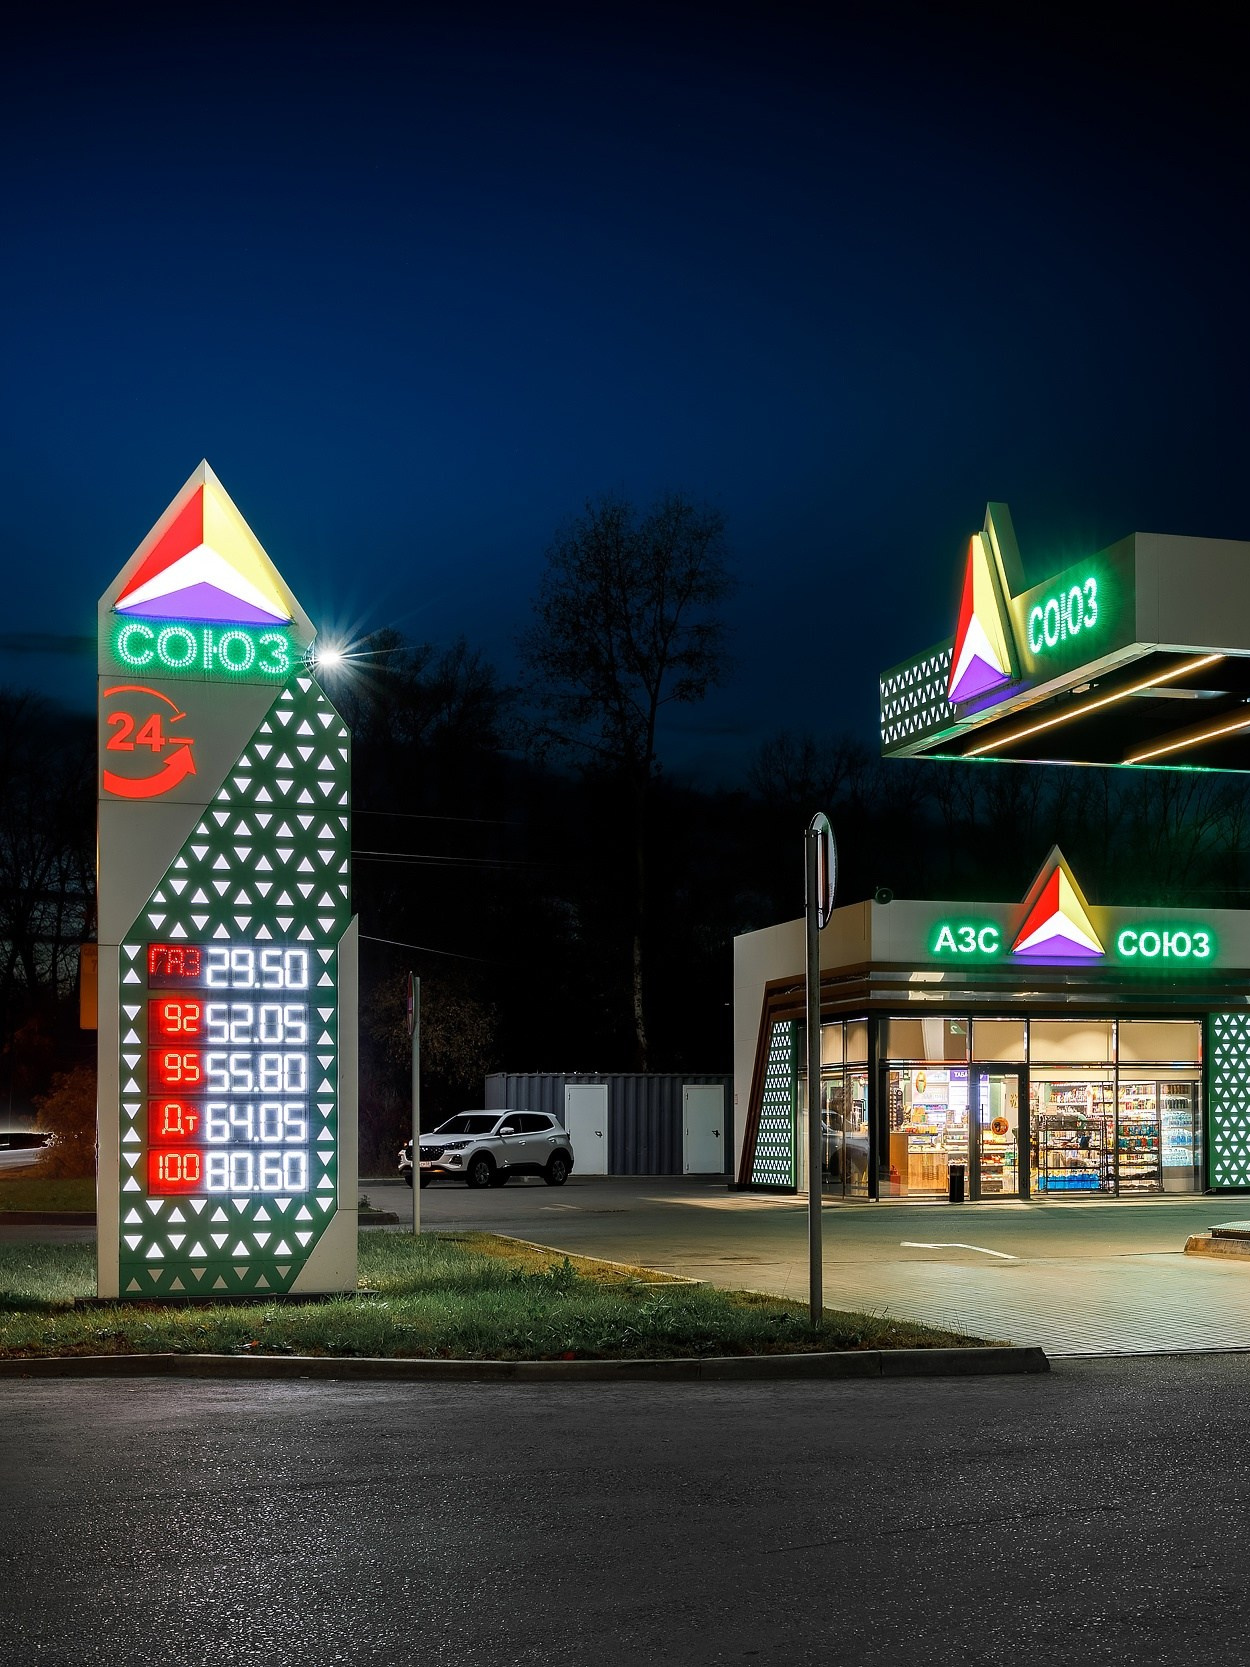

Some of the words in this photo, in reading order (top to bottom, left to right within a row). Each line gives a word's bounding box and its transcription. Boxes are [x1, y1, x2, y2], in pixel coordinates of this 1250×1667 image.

[1028, 578, 1098, 653] СОЮЗ
[118, 624, 290, 673] СОЮЗ
[106, 712, 166, 752] 24
[934, 926, 999, 952] АЗС
[1118, 930, 1210, 957] СОЮЗ
[151, 949, 200, 976] ГАЗ
[207, 948, 309, 987] 29.50
[164, 1004, 200, 1032] 92
[206, 1004, 307, 1043] 52.05
[164, 1053, 200, 1081] 95
[206, 1053, 307, 1092] 55.80
[206, 1103, 306, 1142] 64.05
[158, 1153, 200, 1181] 100
[206, 1152, 306, 1191] 80.60
